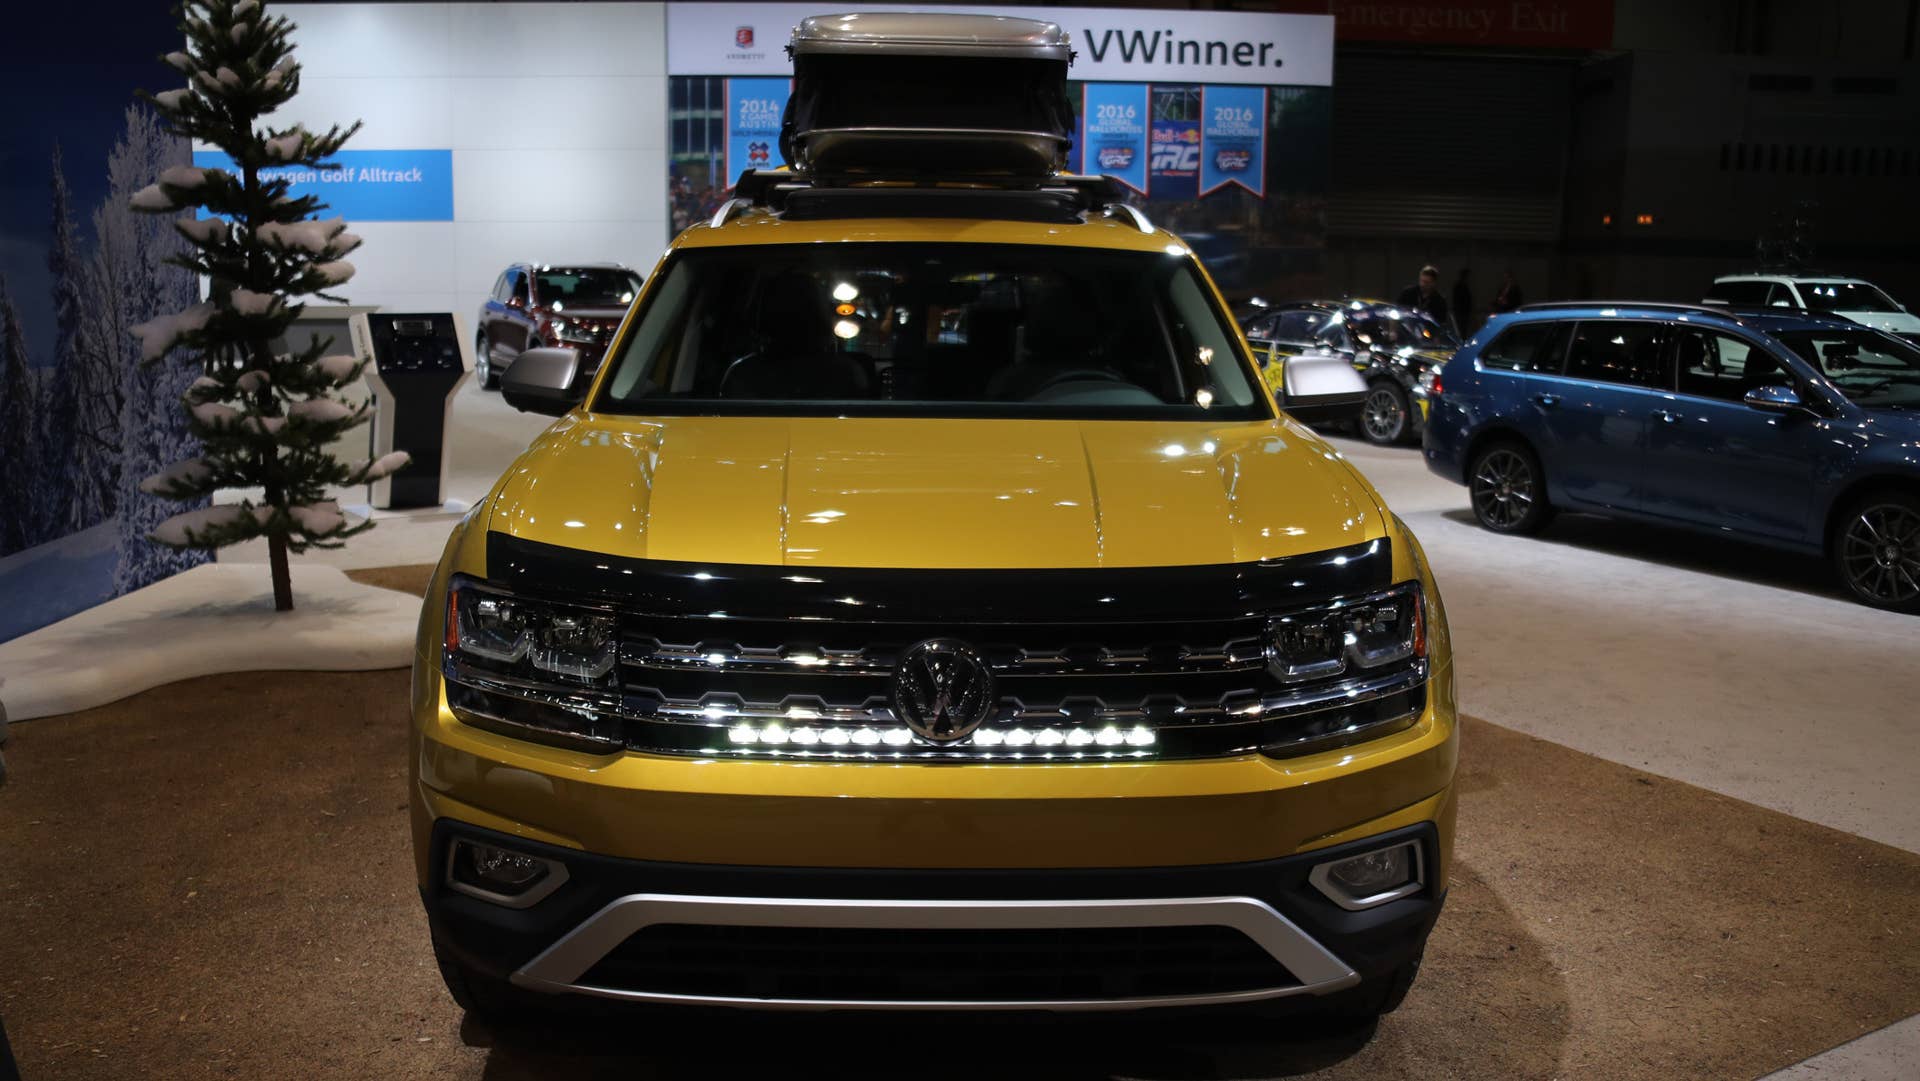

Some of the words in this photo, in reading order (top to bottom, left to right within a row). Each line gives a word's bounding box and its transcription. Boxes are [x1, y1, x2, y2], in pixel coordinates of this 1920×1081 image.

[1511, 0, 1568, 33] Exit
[1083, 29, 1284, 68] VWinner.
[740, 99, 779, 113] 2014
[1096, 104, 1136, 119] 2016
[1214, 107, 1253, 121] 2016
[739, 120, 779, 129] AUSTIN
[320, 168, 355, 183] Golf
[358, 168, 422, 183] Alltrack
